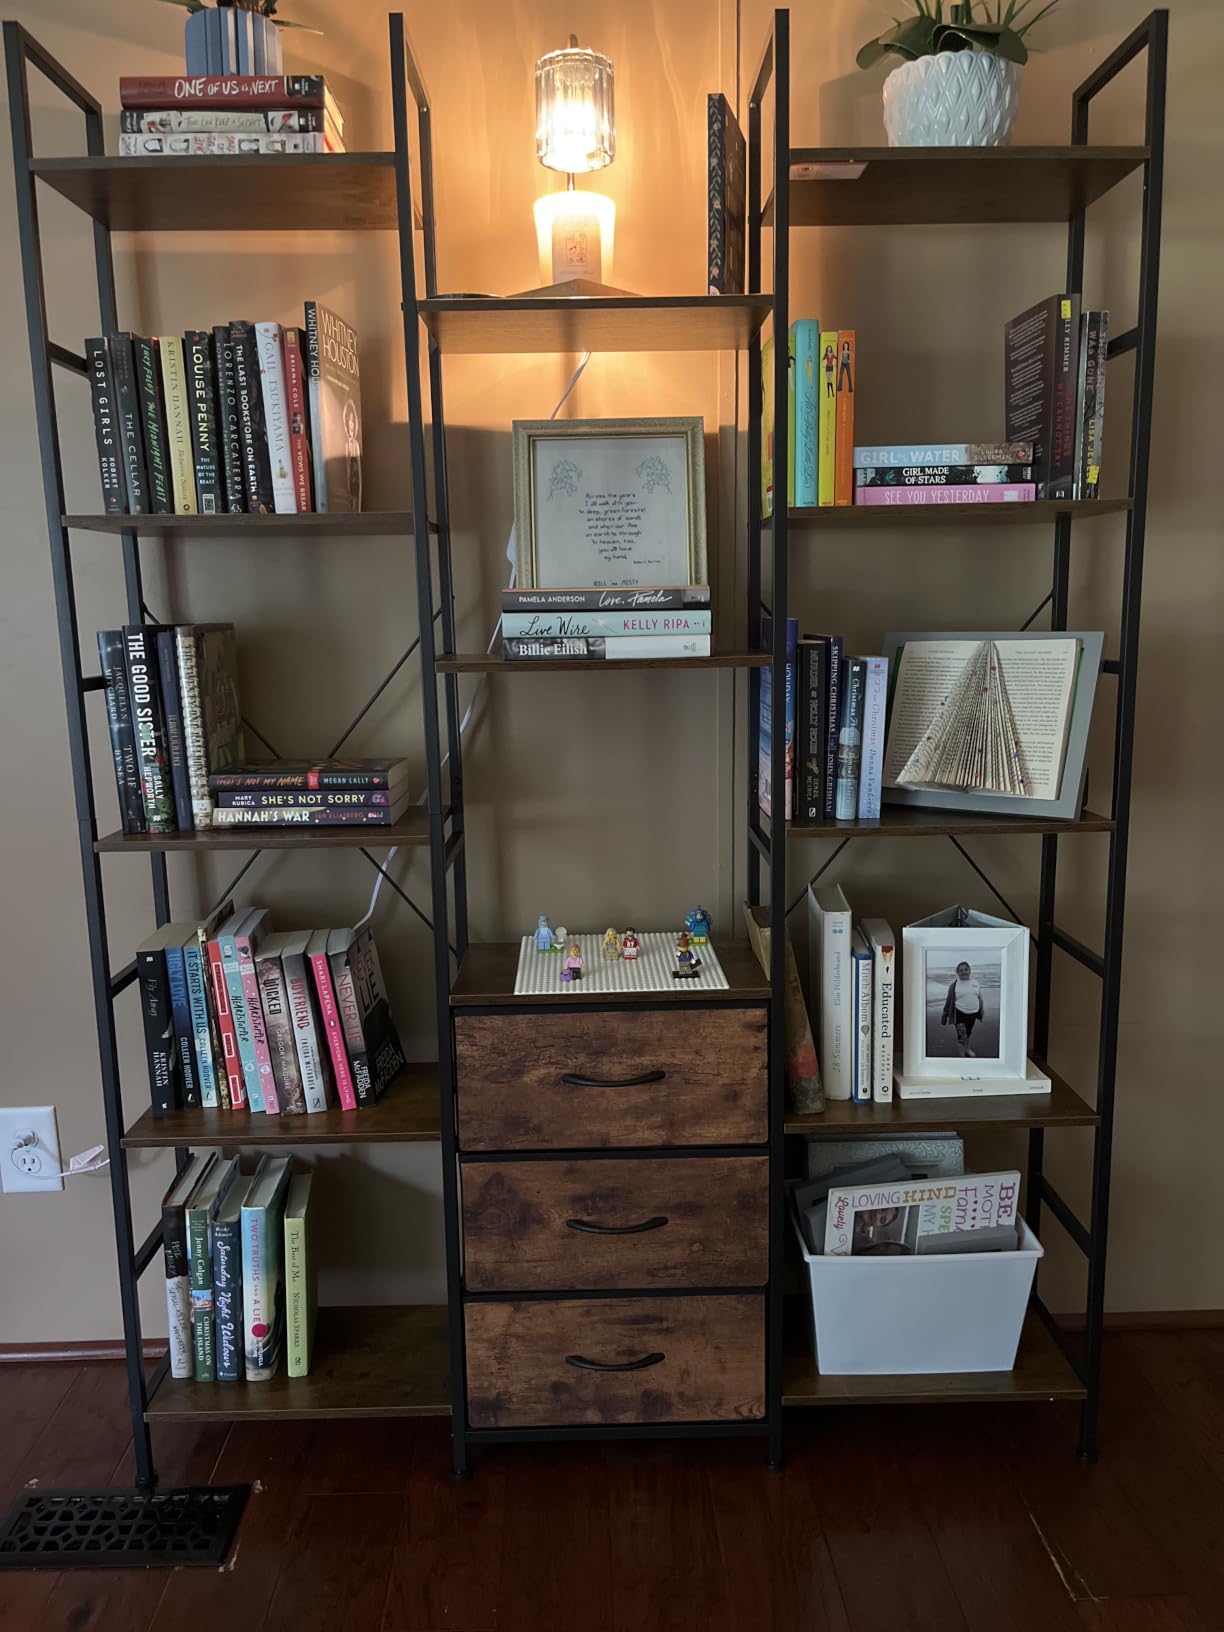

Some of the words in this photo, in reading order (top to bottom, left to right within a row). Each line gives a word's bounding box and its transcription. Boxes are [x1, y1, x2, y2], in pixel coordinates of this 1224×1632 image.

[175, 78, 207, 98] ONE
[208, 81, 219, 95] OF
[223, 80, 240, 95] US
[250, 79, 279, 95] NEXT
[308, 309, 319, 357] WHITNEY
[321, 310, 358, 356] WHITNEY
[1087, 330, 1097, 354] WAS
[141, 344, 151, 366] LUCY
[167, 341, 182, 393] KRISTIN
[236, 345, 245, 363] THE
[263, 342, 276, 374] GAIL
[322, 334, 360, 378] HOUSTON
[1063, 336, 1071, 373] RIMMER
[143, 367, 155, 396] FOLEY
[192, 345, 207, 399] LOUISE
[223, 343, 236, 406] LORENZO
[238, 365, 248, 387] LAST
[289, 354, 297, 385] BRIANA
[1086, 360, 1096, 392] GONE
[94, 351, 106, 388] LOST
[100, 398, 113, 445] GIRLS
[125, 413, 135, 439] THE
[171, 395, 183, 444] HANNAH
[196, 403, 210, 452] PENNY
[240, 389, 253, 444] BOOKSTORE
[269, 379, 285, 452] TSUKIYAMA
[1088, 418, 1096, 443] LISA
[148, 420, 163, 470] MIDNIGHT
[228, 414, 242, 499] CARCATERRA
[246, 447, 255, 462] ON
[860, 451, 899, 465] GIRL
[910, 449, 960, 463] WATER
[102, 457, 110, 489] KOLKER
[110, 457, 118, 489] ROBERT
[129, 446, 141, 497] CELLAR
[298, 450, 306, 472] VOWS
[903, 468, 923, 477] GIRL
[924, 467, 950, 476] MADE
[153, 472, 167, 504] FEAST
[249, 464, 257, 493] EARTH
[299, 473, 306, 487] WE
[905, 476, 917, 485] OF
[918, 476, 947, 484] STARS
[300, 487, 308, 511] BREAK
[884, 492, 902, 505] SEE
[907, 491, 926, 504] YOU
[931, 490, 990, 504] YESTERDAY
[627, 590, 673, 608] Pamela
[520, 615, 552, 637] Live
[557, 616, 591, 635] Wire
[623, 619, 658, 631] KELLY
[664, 619, 690, 630] RIPA
[128, 633, 146, 660] THE
[519, 644, 552, 656] Billie
[554, 643, 588, 655] Eilish
[831, 646, 840, 685] SKIPPING
[105, 668, 118, 720] MITCHARD
[113, 666, 128, 720] JACQUELYN
[131, 665, 151, 704] GOOD
[850, 678, 861, 716] Christmas
[829, 686, 838, 733] CHRISTMAS
[114, 750, 123, 763] BY
[123, 744, 135, 773] TWO
[827, 753, 836, 776] JOHN
[868, 748, 878, 776] Donna
[116, 766, 125, 785] SEA
[127, 777, 137, 789] IF
[144, 766, 156, 810] HEPWORTH
[154, 775, 164, 800] SALLY
[263, 776, 276, 785] MY
[276, 775, 305, 786] NAME
[261, 796, 295, 805] SHE'S
[298, 796, 323, 805] NOT
[328, 795, 366, 804] SORRY
[825, 777, 834, 813] GRISHAM
[217, 811, 279, 823] HANNAH'S
[283, 811, 310, 822] WAR
[167, 952, 184, 981] UGLY
[187, 951, 198, 960] IT
[187, 962, 203, 995] STARTS
[861, 962, 870, 989] Mitch
[171, 982, 186, 1009] LOVE
[193, 996, 206, 1020] WITH
[291, 977, 310, 1030] BOYFRIEND
[336, 973, 357, 1024] NEVER
[860, 991, 870, 1023] Albom
[231, 995, 249, 1043] HEARTSTOPPER
[247, 997, 266, 1045] HEARTSTOPPER
[881, 982, 893, 1039] Educated
[196, 1022, 207, 1034] US
[263, 977, 283, 1016] WICKED
[276, 1028, 287, 1059] GREGORY
[282, 1061, 292, 1090] MAGUIRE
[316, 960, 326, 984] SHARI
[321, 985, 333, 1015] LAPENA
[331, 1031, 343, 1062] EVERYONE
[337, 1063, 346, 1079] HERE
[343, 1087, 352, 1104] LYING
[346, 1025, 362, 1043] LIE
[834, 1025, 842, 1059] Summers
[180, 1037, 190, 1063] COLLEEN
[199, 1038, 208, 1063] COLLEEN
[153, 1051, 163, 1087] HANNAH
[160, 1052, 169, 1086] KRISTIN
[183, 1064, 194, 1089] HOOVER
[202, 1065, 212, 1090] HOOVER
[352, 1060, 368, 1099] McFADDEN
[362, 1066, 372, 1089] FREIDA
[832, 1061, 841, 1073] 28
[852, 1190, 901, 1208] LOVING
[924, 1204, 937, 1226] MY
[250, 1218, 260, 1241] TWO
[291, 1232, 299, 1245] The
[195, 1237, 205, 1258] Jenny
[195, 1259, 206, 1285] Colgan
[215, 1241, 231, 1288] Saturday
[251, 1244, 260, 1282] TRUTHS
[216, 1292, 233, 1320] Night
[253, 1308, 261, 1323] LIE
[196, 1322, 204, 1336] THE
[203, 1316, 211, 1353] CHRISTMAS
[197, 1337, 206, 1361] ISLAND
[220, 1322, 235, 1369] Widows
[205, 1355, 212, 1366] ON
